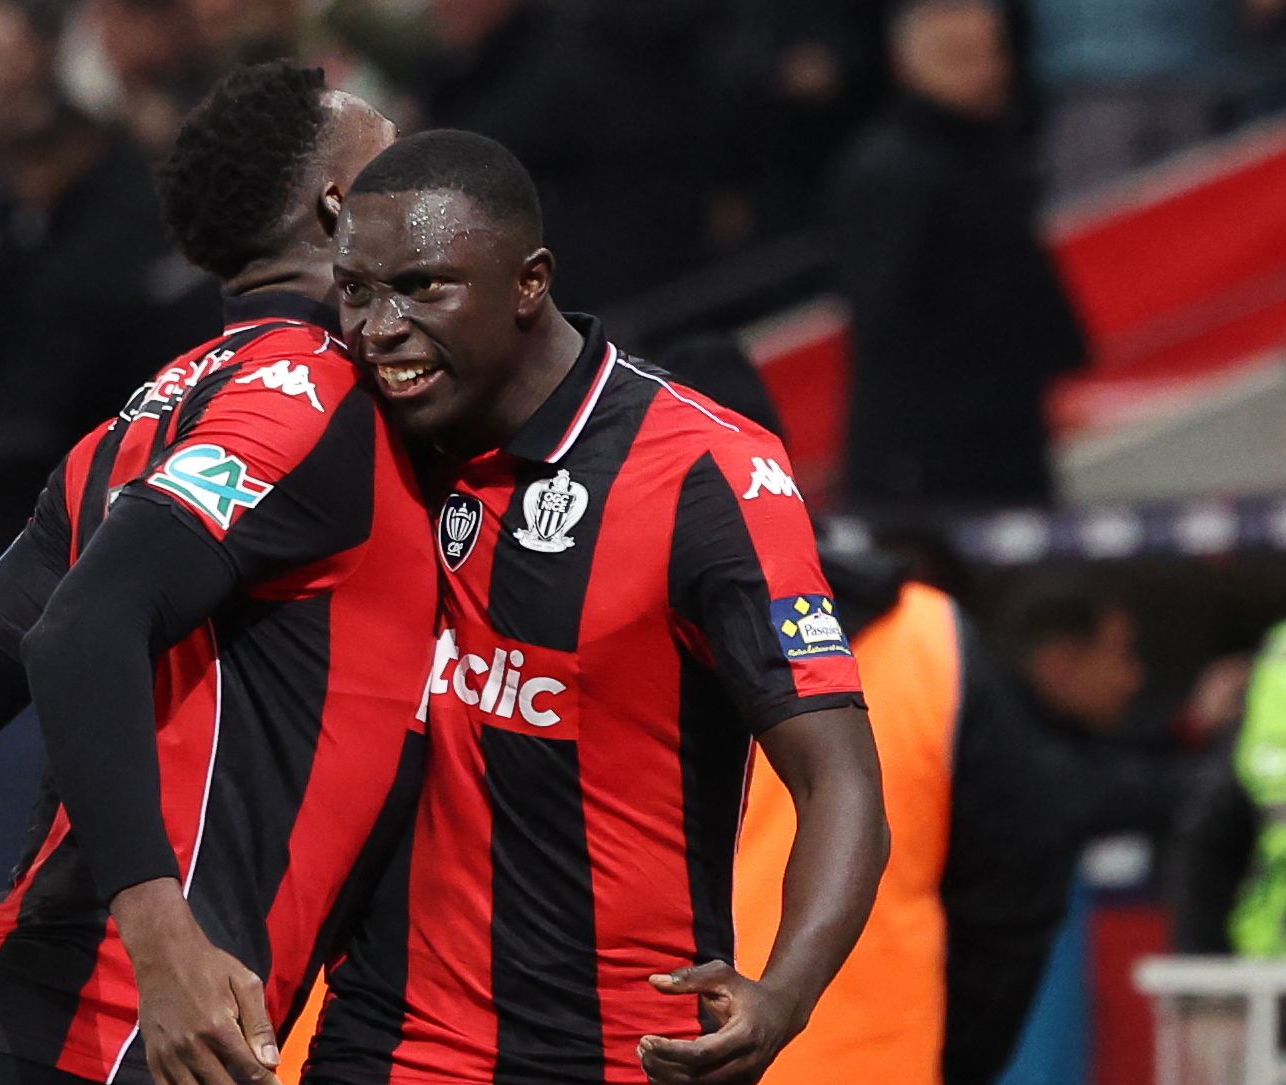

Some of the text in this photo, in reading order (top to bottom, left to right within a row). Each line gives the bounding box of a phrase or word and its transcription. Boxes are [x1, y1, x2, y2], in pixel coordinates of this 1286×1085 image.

[543, 491, 570, 503] OGC
[540, 500, 567, 513] NICE
[430, 629, 568, 727] tclic
